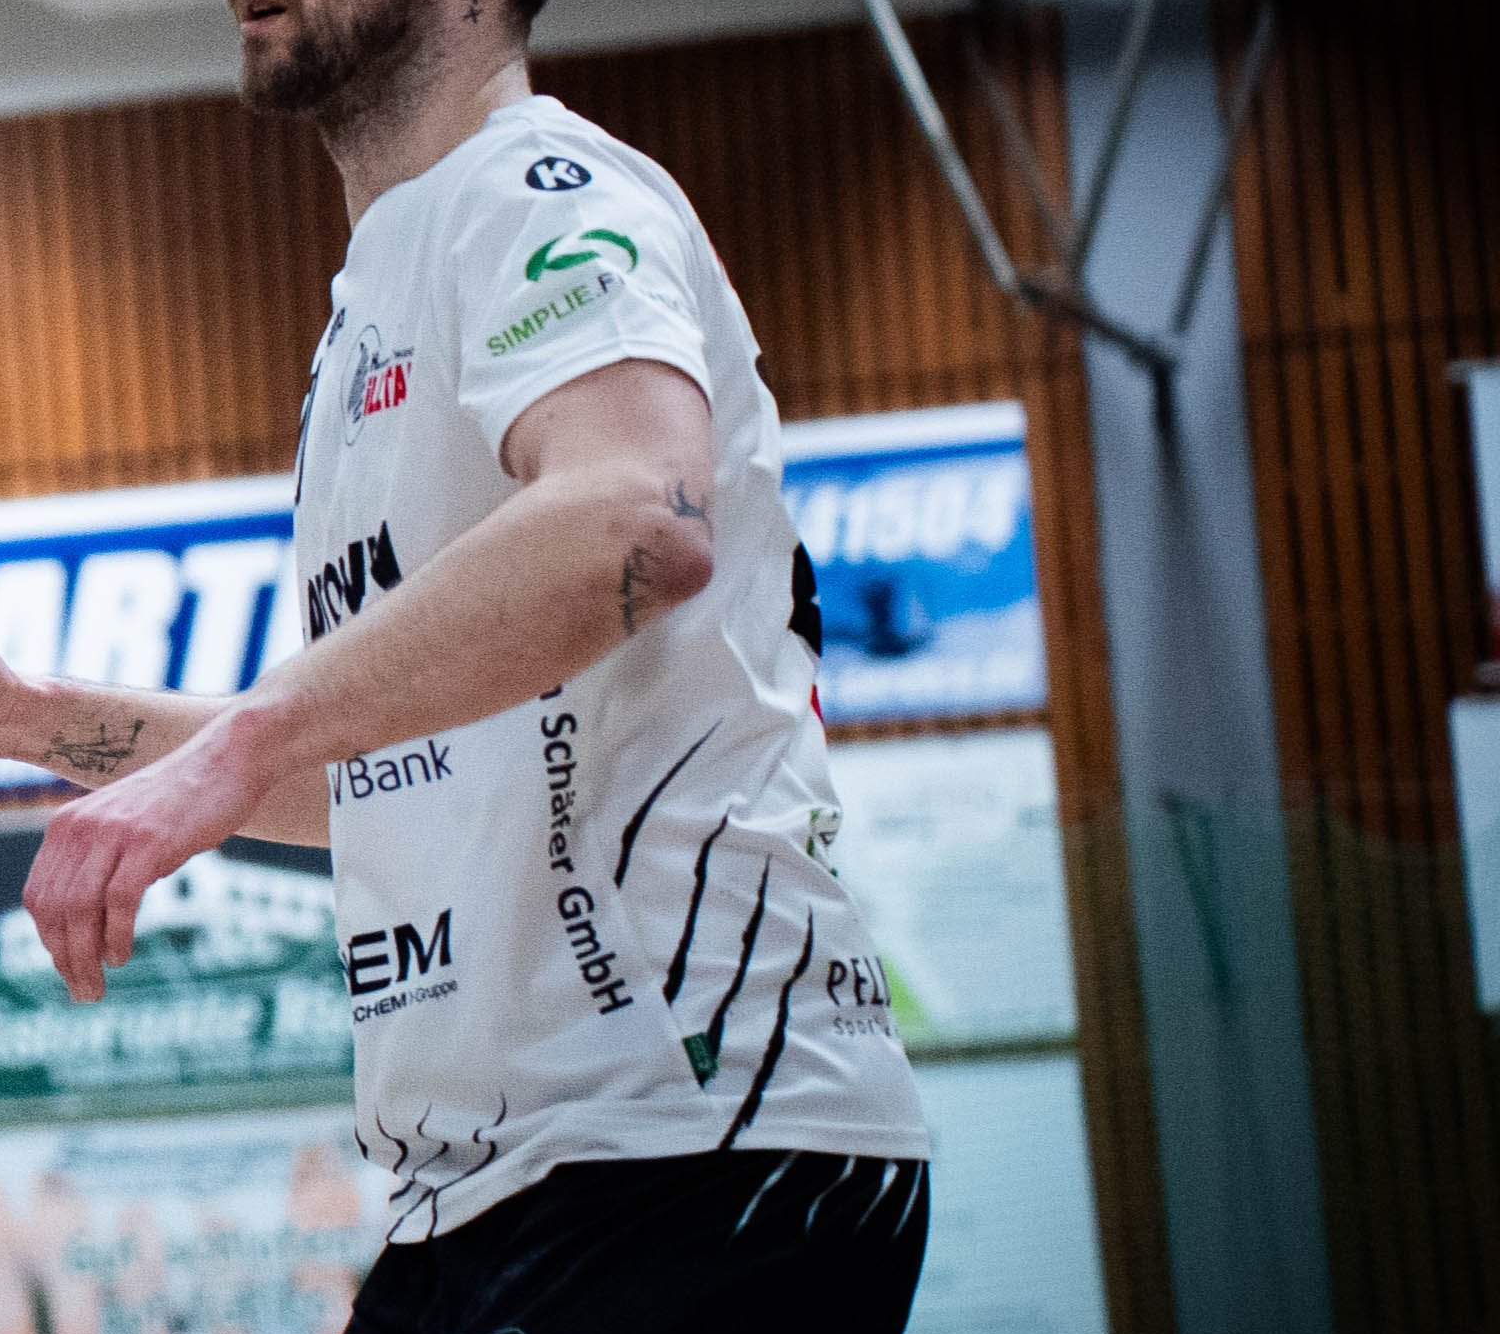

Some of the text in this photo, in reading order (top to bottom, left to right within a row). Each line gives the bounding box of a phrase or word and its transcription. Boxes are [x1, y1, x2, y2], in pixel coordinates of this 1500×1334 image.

[346, 739, 453, 801] Bank
[540, 713, 635, 1016] Schäfer GmbH
